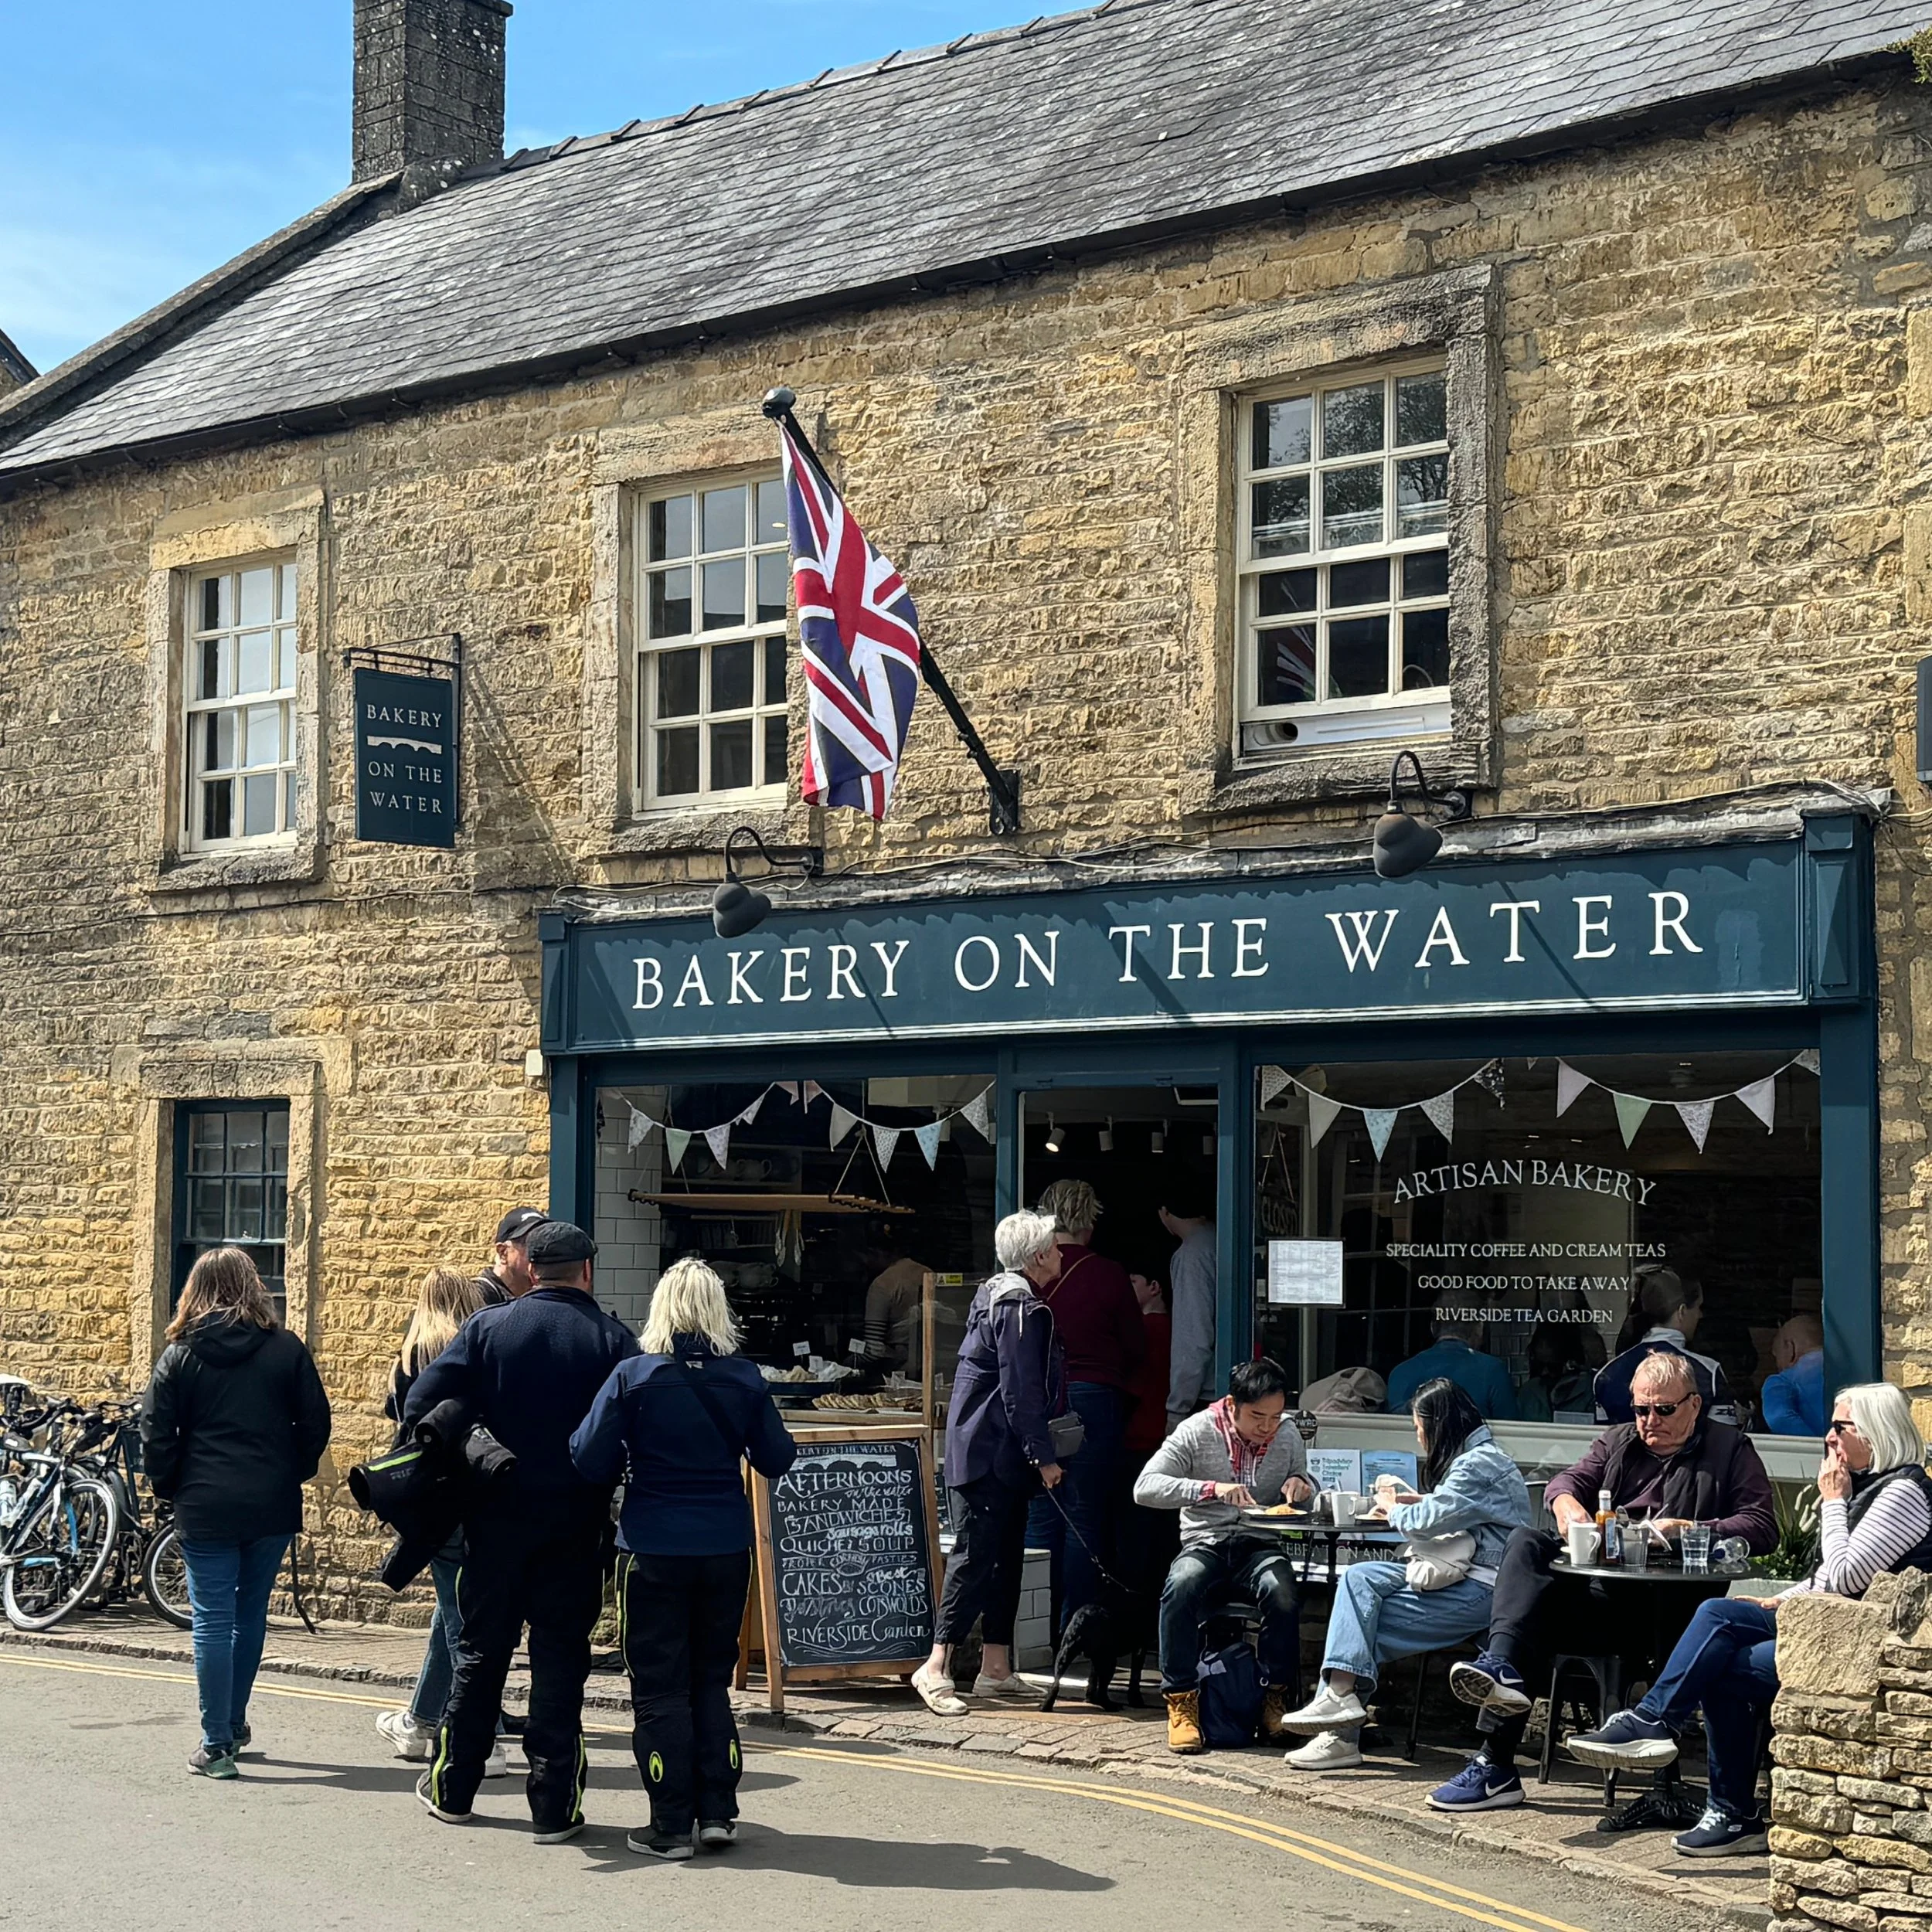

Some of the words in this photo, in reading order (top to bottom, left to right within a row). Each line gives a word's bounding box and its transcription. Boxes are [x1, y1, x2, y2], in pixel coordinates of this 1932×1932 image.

[366, 704, 442, 728] BAKERY
[368, 761, 395, 777] ON
[404, 765, 442, 783] THE
[369, 791, 442, 814] WATER
[631, 940, 911, 1010] BAKERY
[954, 930, 1060, 992] ON
[1108, 917, 1269, 983] THE
[1324, 890, 1704, 974] WATER
[1393, 1160, 1523, 1204] ARTISAN
[1531, 1160, 1657, 1206] BAKERY
[1386, 1243, 1468, 1257] SPECIALITY
[1470, 1243, 1526, 1257] COFFEE
[1529, 1243, 1563, 1257] AND
[1566, 1243, 1622, 1257] CREAM
[1624, 1243, 1666, 1257] TEAS
[1417, 1275, 1463, 1289] GOOD
[1465, 1275, 1508, 1290] FOOD
[1510, 1276, 1533, 1290] TO
[1535, 1276, 1577, 1291] TAKE
[1435, 1307, 1512, 1322] RIVERSIDE
[1513, 1308, 1545, 1322] TEA
[1547, 1309, 1613, 1323] GARDEN
[774, 1469, 913, 1498] AFTERNOONS
[777, 1498, 842, 1512] BAKERY
[852, 1497, 906, 1509] MADE
[787, 1509, 906, 1535] SANDWICHES
[858, 1536, 914, 1552] SOUP
[782, 1573, 842, 1596] CAKES
[857, 1578, 926, 1597] SCONES
[787, 1621, 872, 1649] RIVERSIDE
